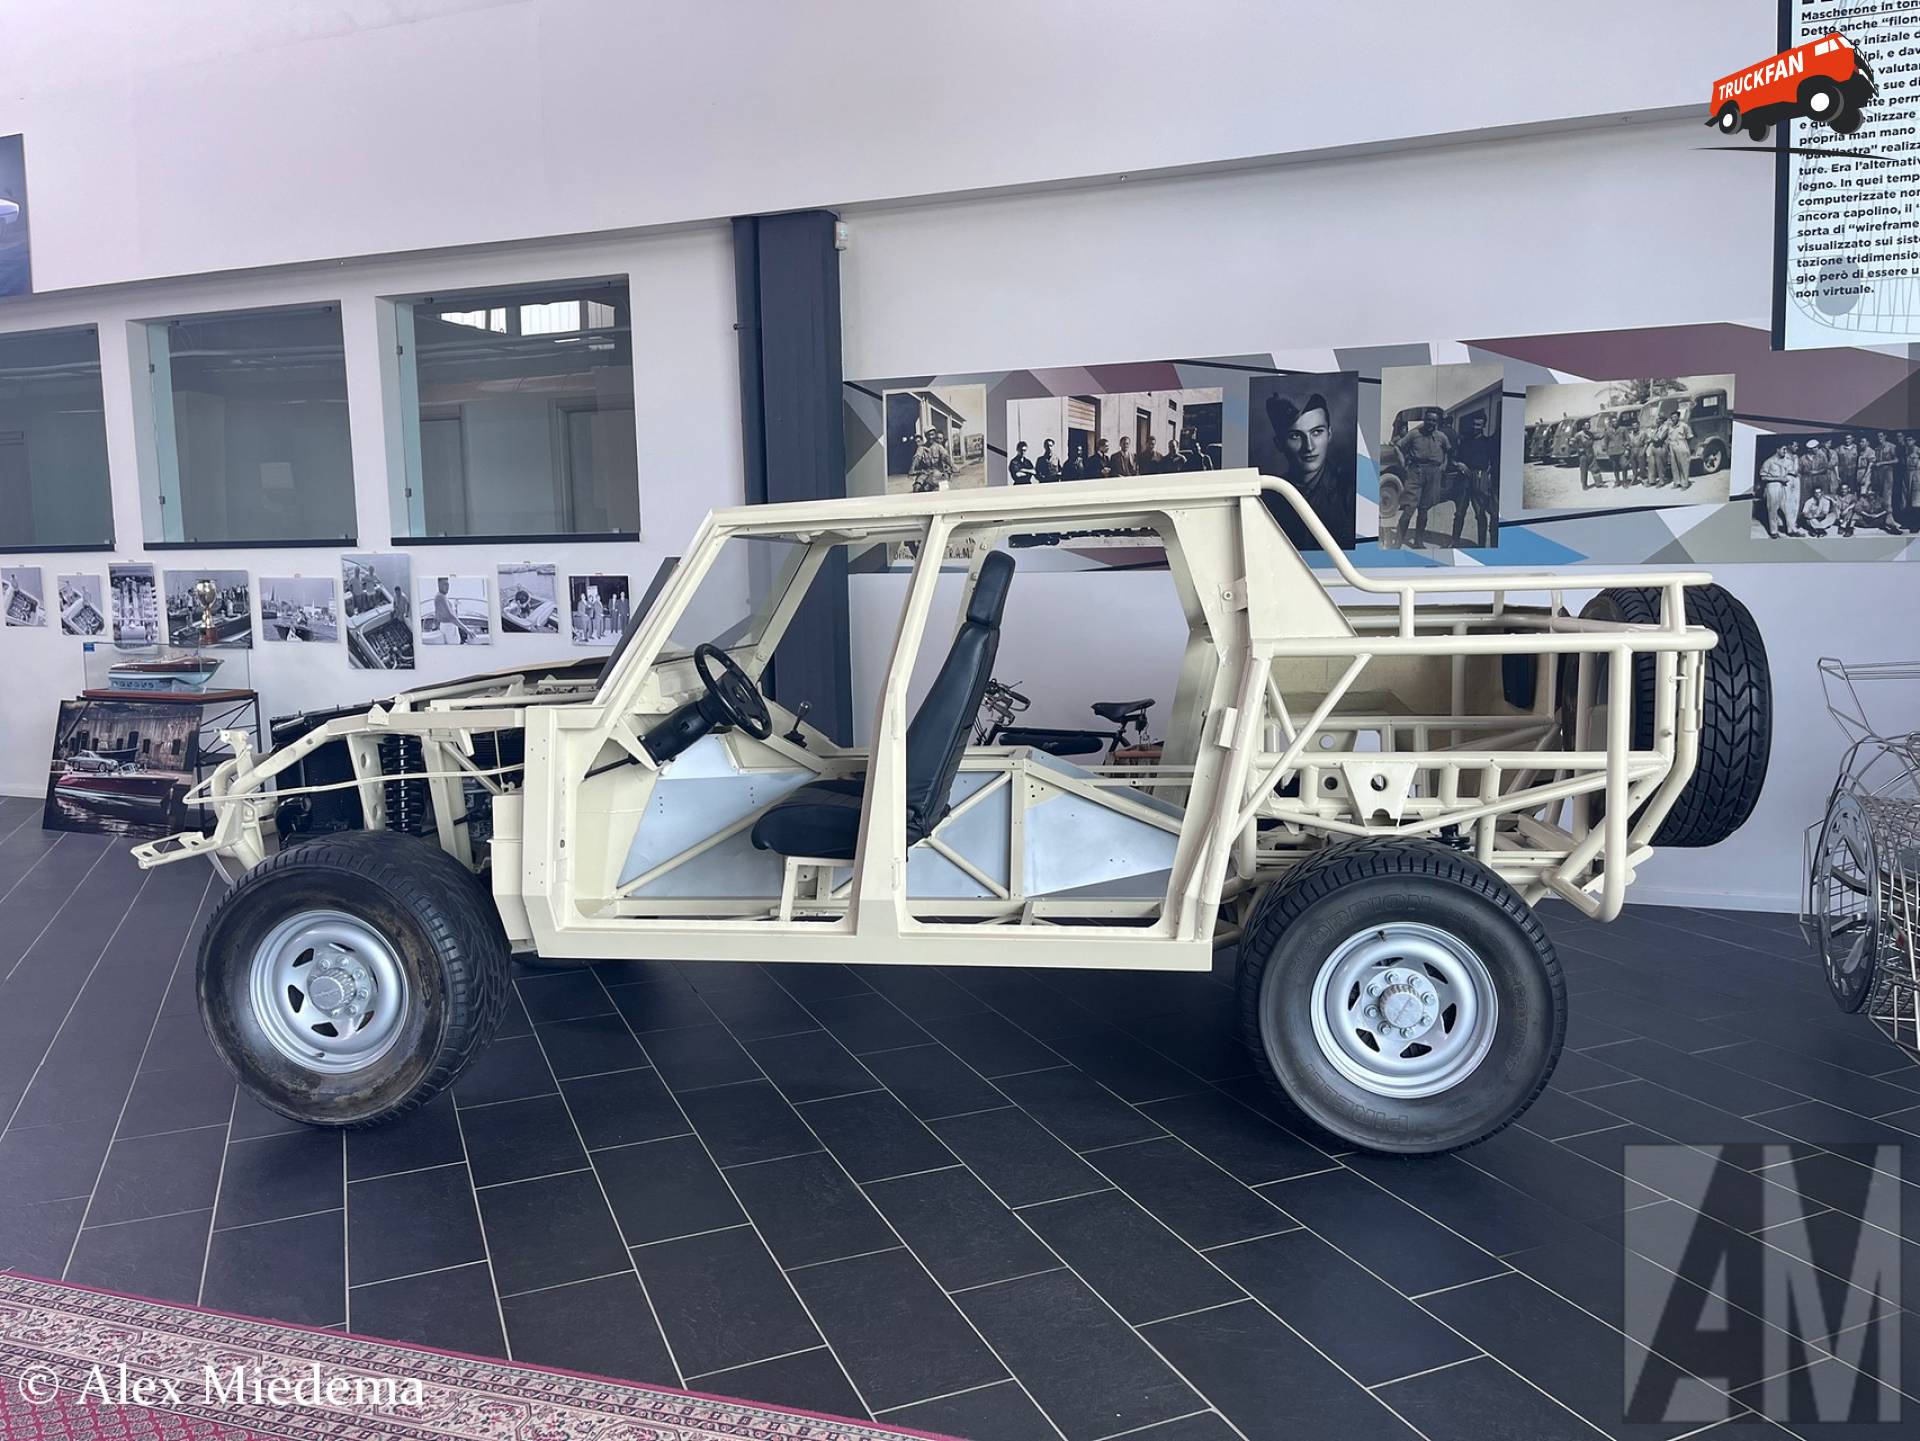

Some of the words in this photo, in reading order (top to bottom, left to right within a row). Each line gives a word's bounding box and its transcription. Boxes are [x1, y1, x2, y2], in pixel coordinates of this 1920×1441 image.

[1802, 5, 1877, 20] Mascherone
[1881, 2, 1893, 11] in
[1897, 0, 1920, 8] ton
[1801, 26, 1836, 36] Detto
[1840, 20, 1878, 31] anche
[1882, 15, 1920, 26] “filon
[1864, 31, 1910, 44] iniziale
[1878, 62, 1920, 74] valuta
[1883, 80, 1905, 90] sue
[1800, 132, 1845, 146] propria
[1849, 130, 1876, 140] man
[1880, 127, 1916, 137] mano
[1799, 166, 1828, 176] ture.
[1831, 163, 1851, 172] Era
[1799, 181, 1837, 192] legno.
[1840, 178, 1852, 187] In
[1856, 174, 1883, 187] quei
[1798, 190, 1896, 206] computerizzate
[1798, 210, 1840, 221] ancora
[1843, 205, 1901, 218] capolino,
[1905, 203, 1912, 213] il
[1798, 227, 1829, 237] sorta
[1833, 224, 1845, 234] di
[1797, 239, 1871, 252] visualizzato
[1875, 235, 1893, 246] sui
[1897, 234, 1920, 245] sist
[1797, 256, 1842, 267] tazione
[1847, 250, 1920, 263] tridimensio
[1796, 273, 1816, 285] gio
[1820, 270, 1848, 283] però
[1852, 269, 1864, 278] di
[1867, 268, 1908, 277] essere
[1796, 289, 1819, 298] non
[1823, 285, 1875, 296] virtuale.
